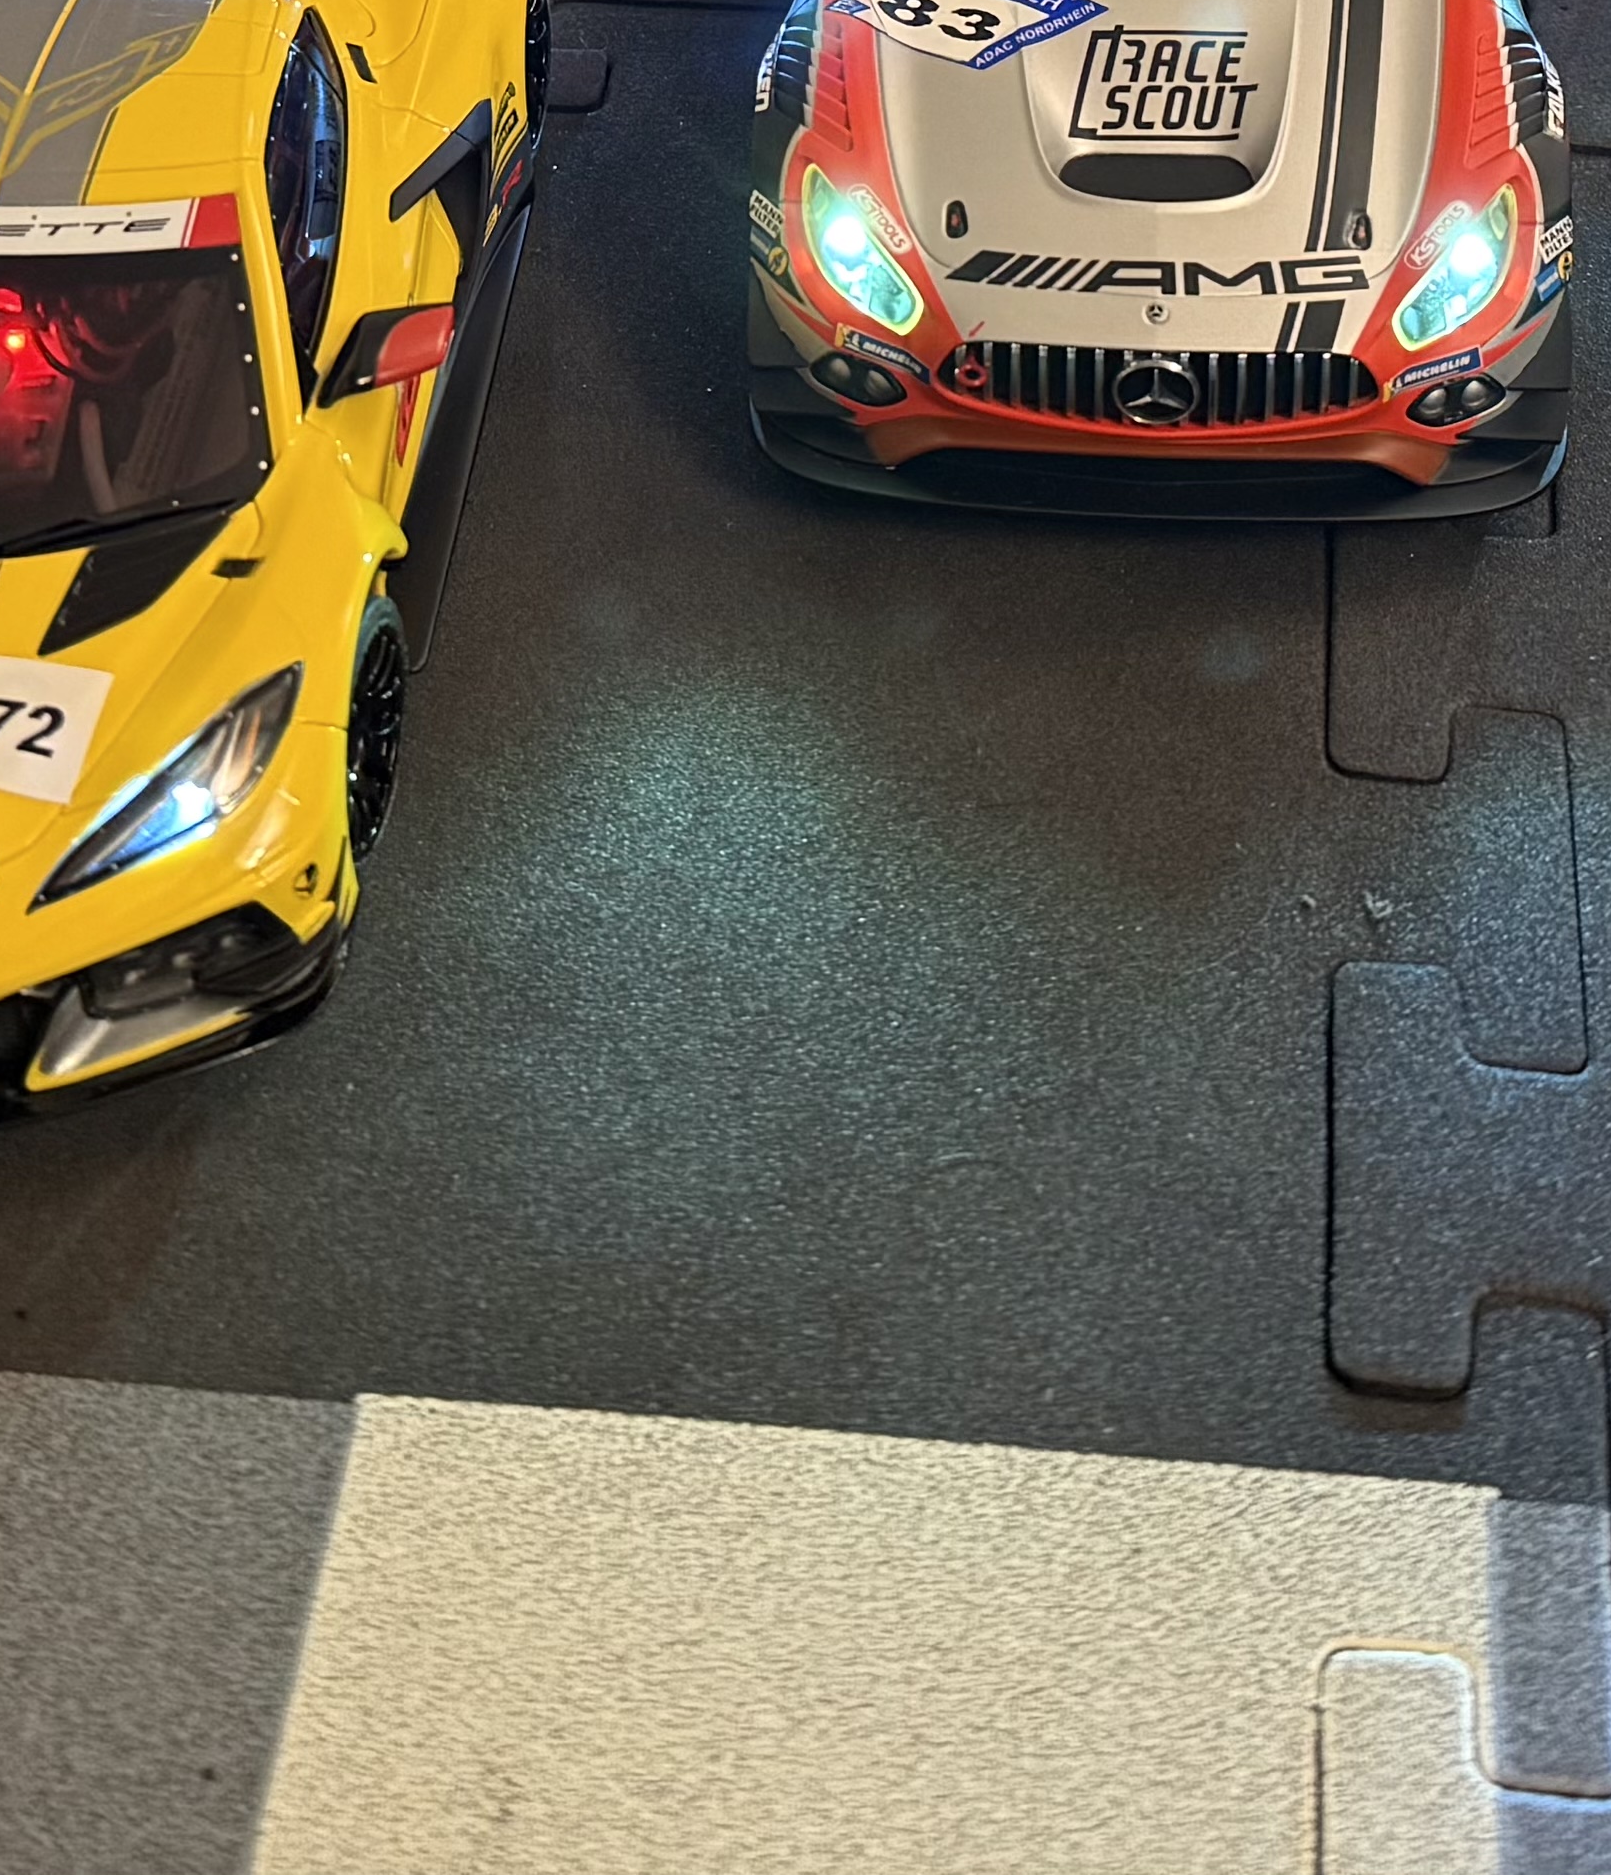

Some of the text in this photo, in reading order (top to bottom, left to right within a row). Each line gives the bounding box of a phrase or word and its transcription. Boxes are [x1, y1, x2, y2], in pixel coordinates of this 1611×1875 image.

[974, 1, 1098, 68] ADAC NORDRHEIN
[1100, 28, 1248, 83] RACE
[1100, 83, 1259, 131] SCOUT
[1076, 255, 1370, 296] AMG
[1403, 355, 1471, 383] MICHELIN
